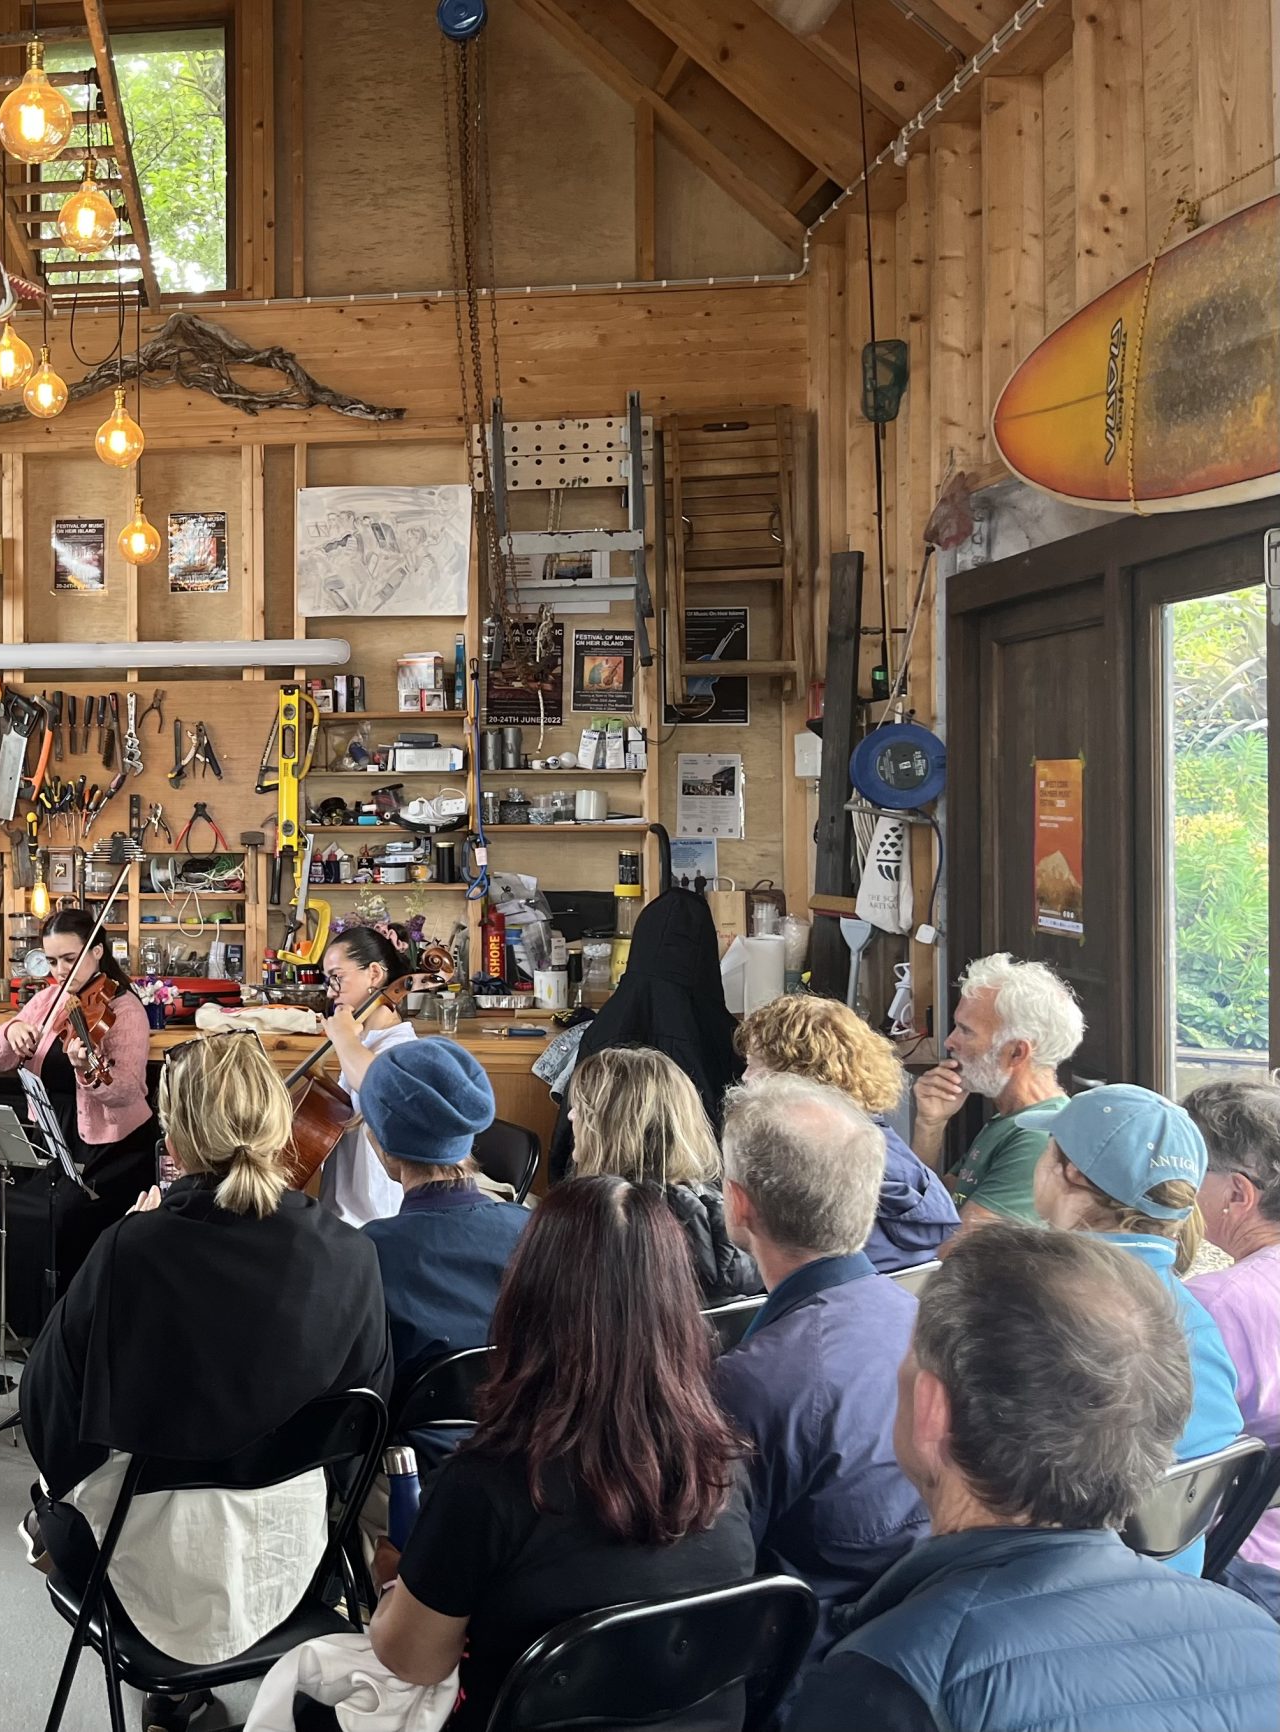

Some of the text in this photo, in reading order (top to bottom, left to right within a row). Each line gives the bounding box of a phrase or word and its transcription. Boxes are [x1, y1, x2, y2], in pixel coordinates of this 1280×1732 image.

[489, 716, 561, 724] 20-24TH JUNE 2022
